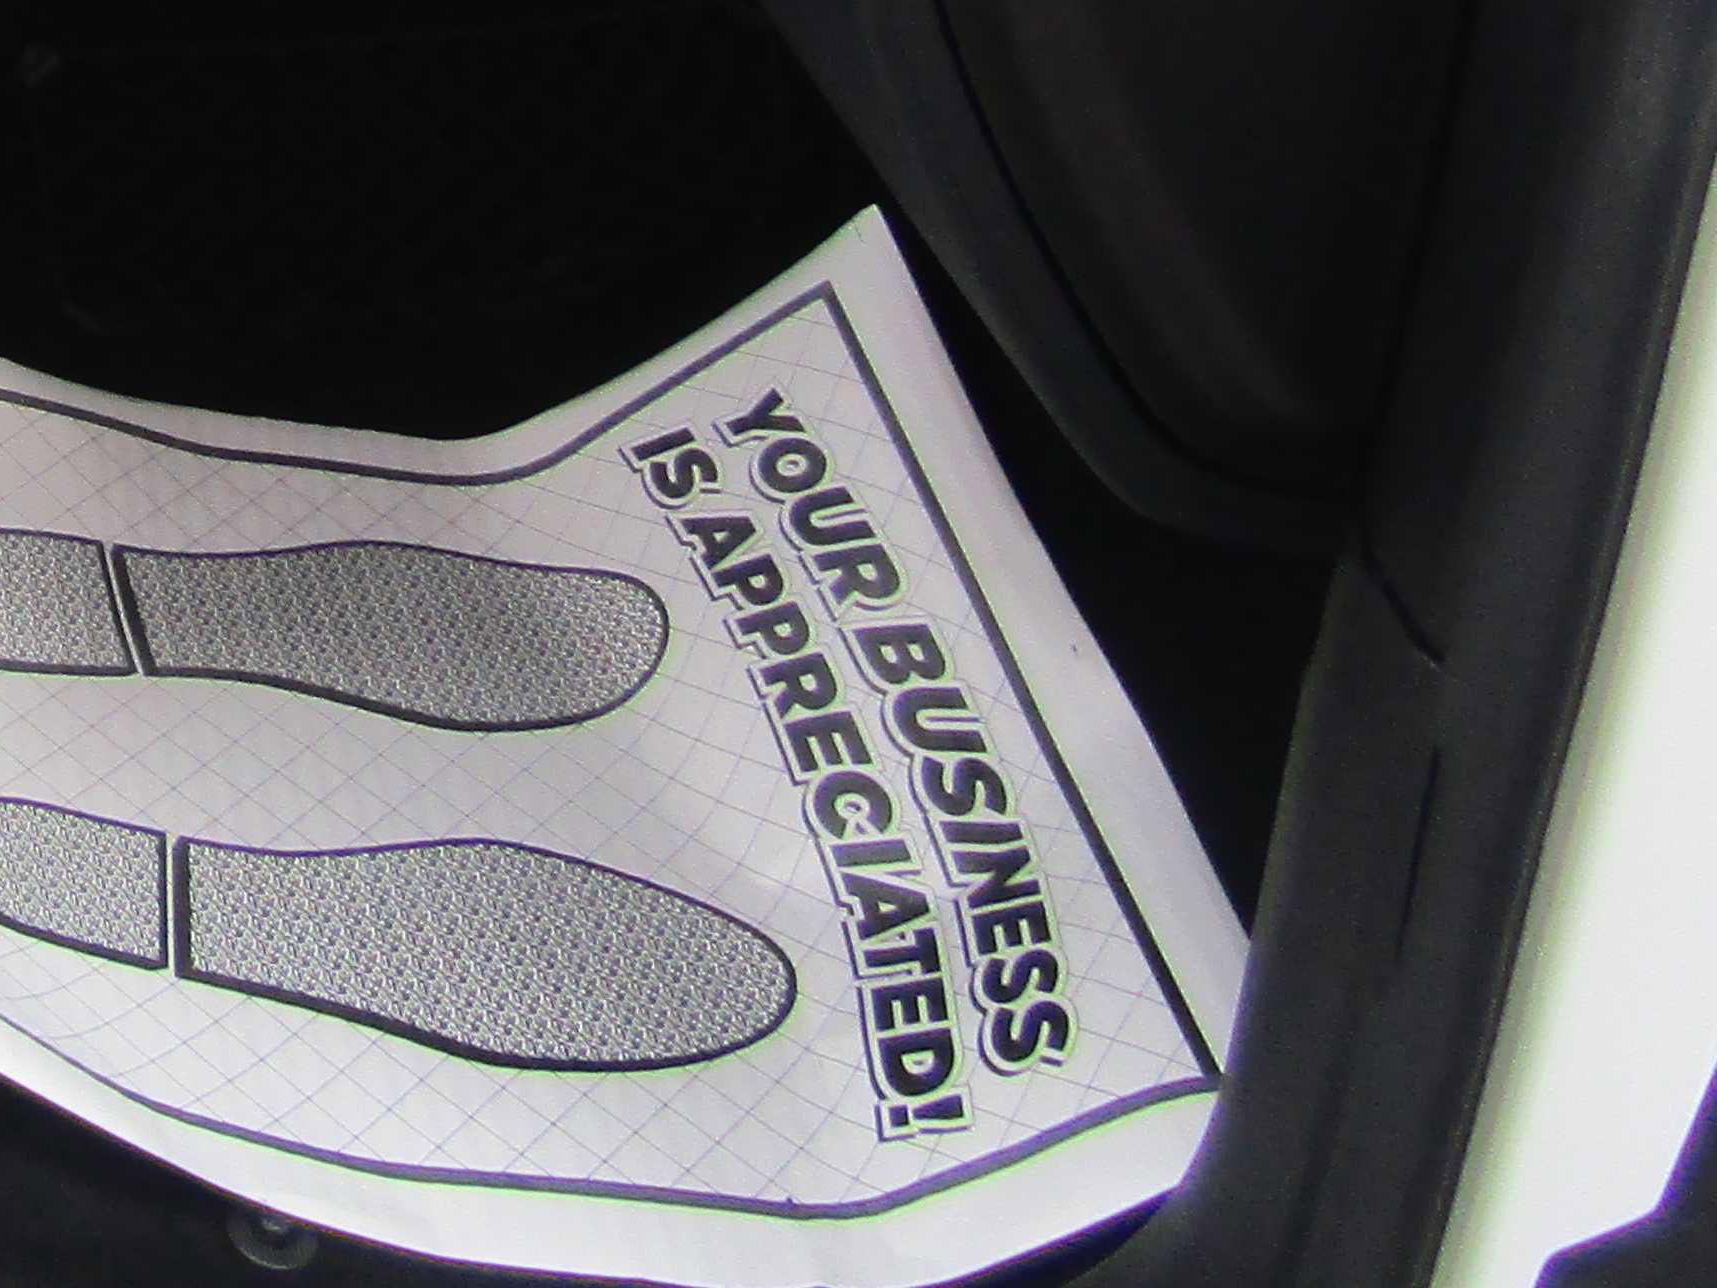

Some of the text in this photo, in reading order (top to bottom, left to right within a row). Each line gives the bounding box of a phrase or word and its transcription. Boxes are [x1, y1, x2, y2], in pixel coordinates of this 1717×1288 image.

[621, 425, 971, 1142] IS APPRECIATED!
[715, 388, 1074, 1076] YOUR BUSINESS
